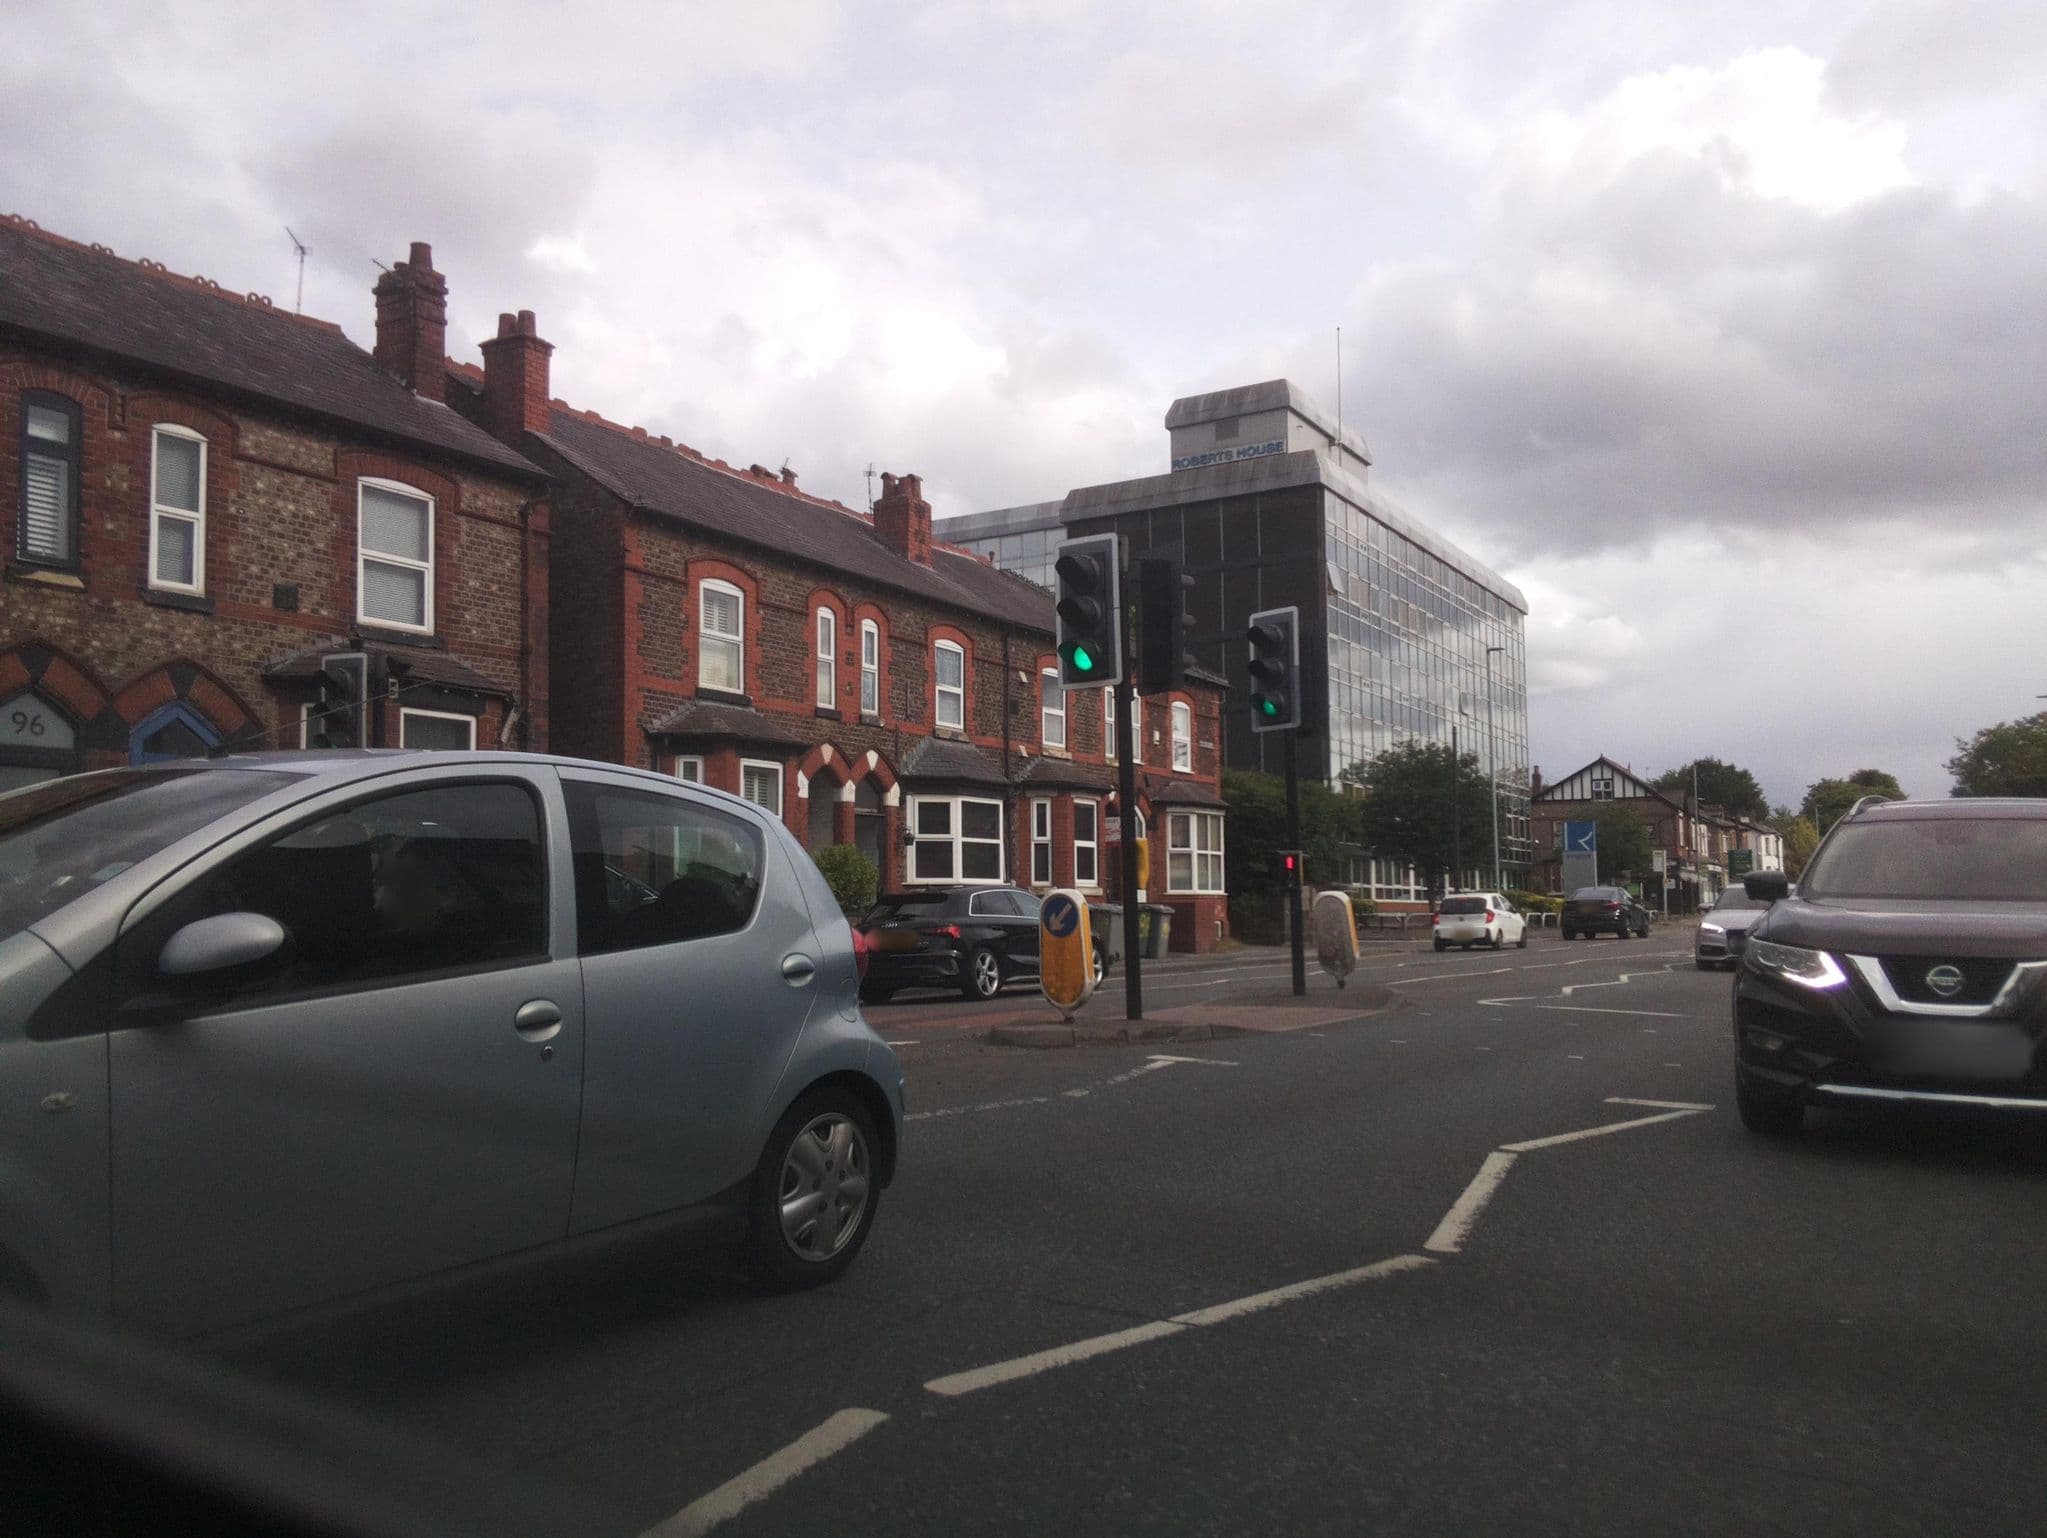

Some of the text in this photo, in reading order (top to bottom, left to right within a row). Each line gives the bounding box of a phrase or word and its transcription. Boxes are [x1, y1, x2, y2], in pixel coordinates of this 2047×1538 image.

[1172, 441, 1284, 469] ROBERTS HOUSE
[12, 711, 45, 736] 96
